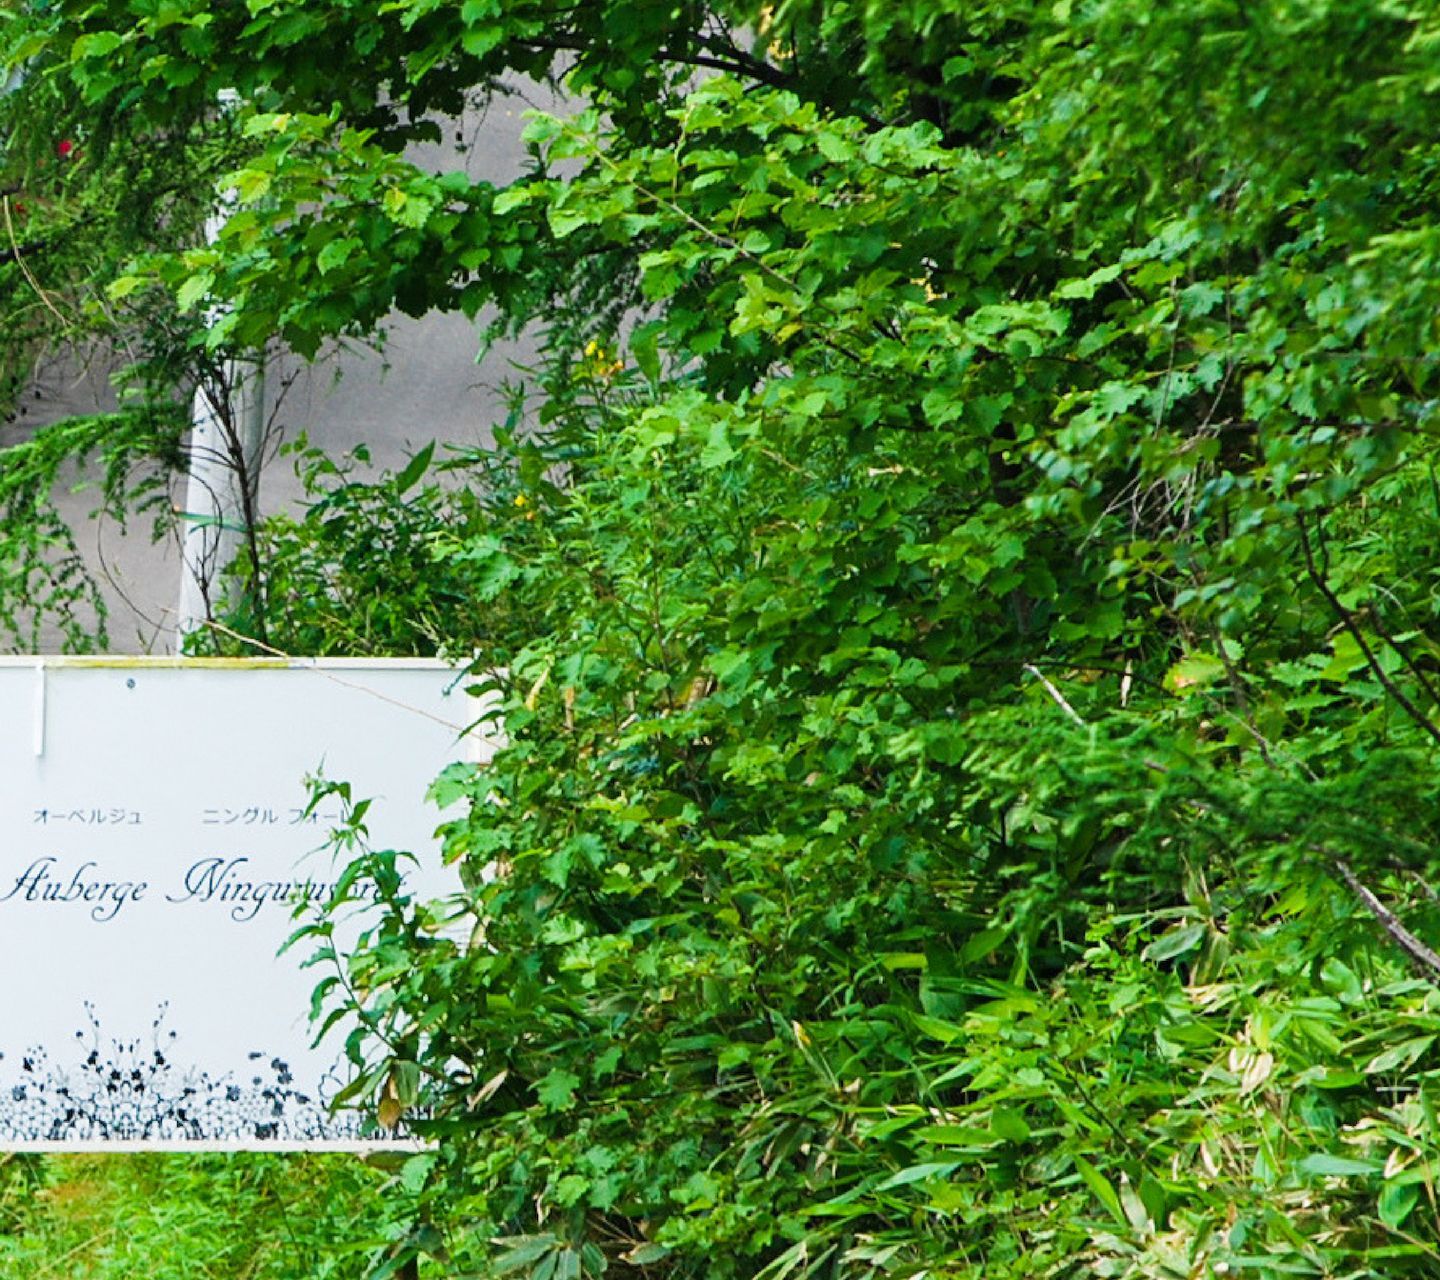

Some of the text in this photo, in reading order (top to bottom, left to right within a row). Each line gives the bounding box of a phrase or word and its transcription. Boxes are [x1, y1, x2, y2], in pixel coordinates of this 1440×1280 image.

[33, 808, 142, 825] オーベルジュ
